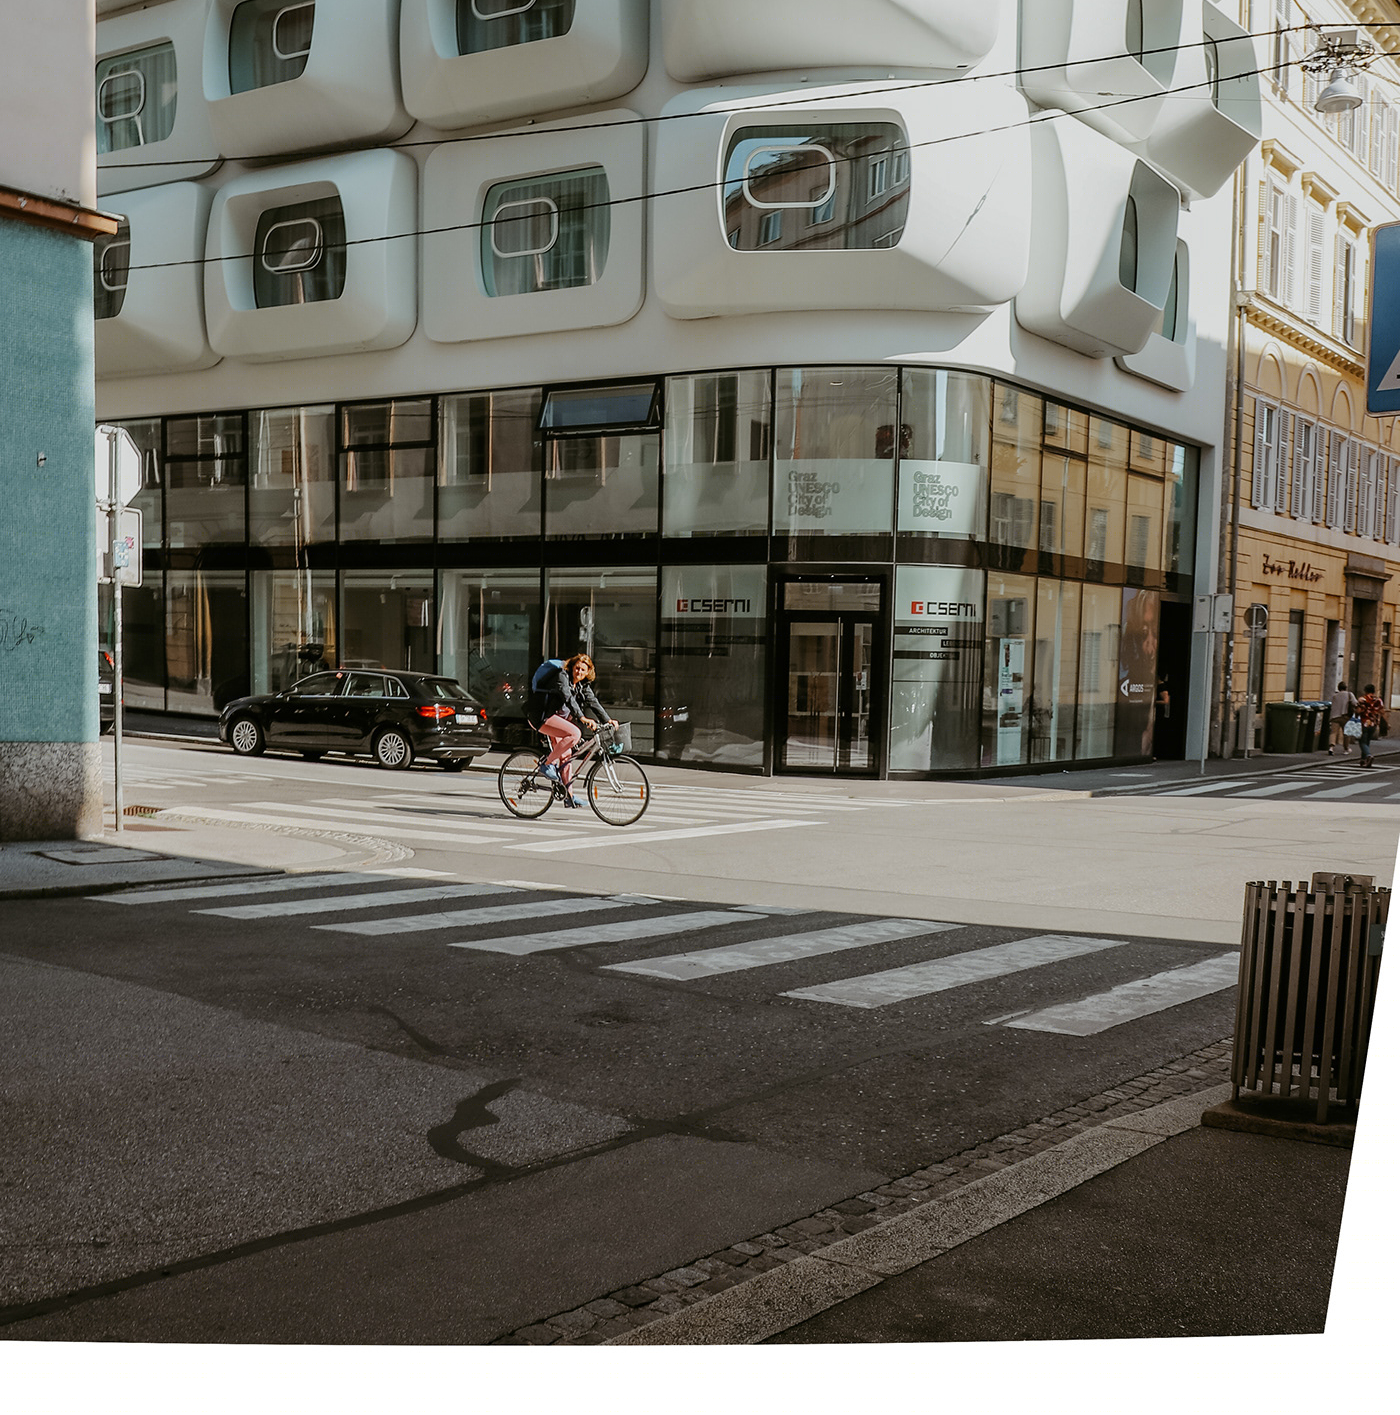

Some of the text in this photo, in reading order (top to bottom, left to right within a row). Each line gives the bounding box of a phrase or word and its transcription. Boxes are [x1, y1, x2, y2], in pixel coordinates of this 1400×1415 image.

[788, 470, 817, 482] Graz
[913, 470, 941, 483] Graz
[788, 482, 840, 494] UNESCO
[913, 483, 959, 497] UNESCO
[788, 493, 829, 507] City of
[913, 494, 950, 509] City of
[788, 504, 832, 518] Design
[913, 504, 952, 521] Design
